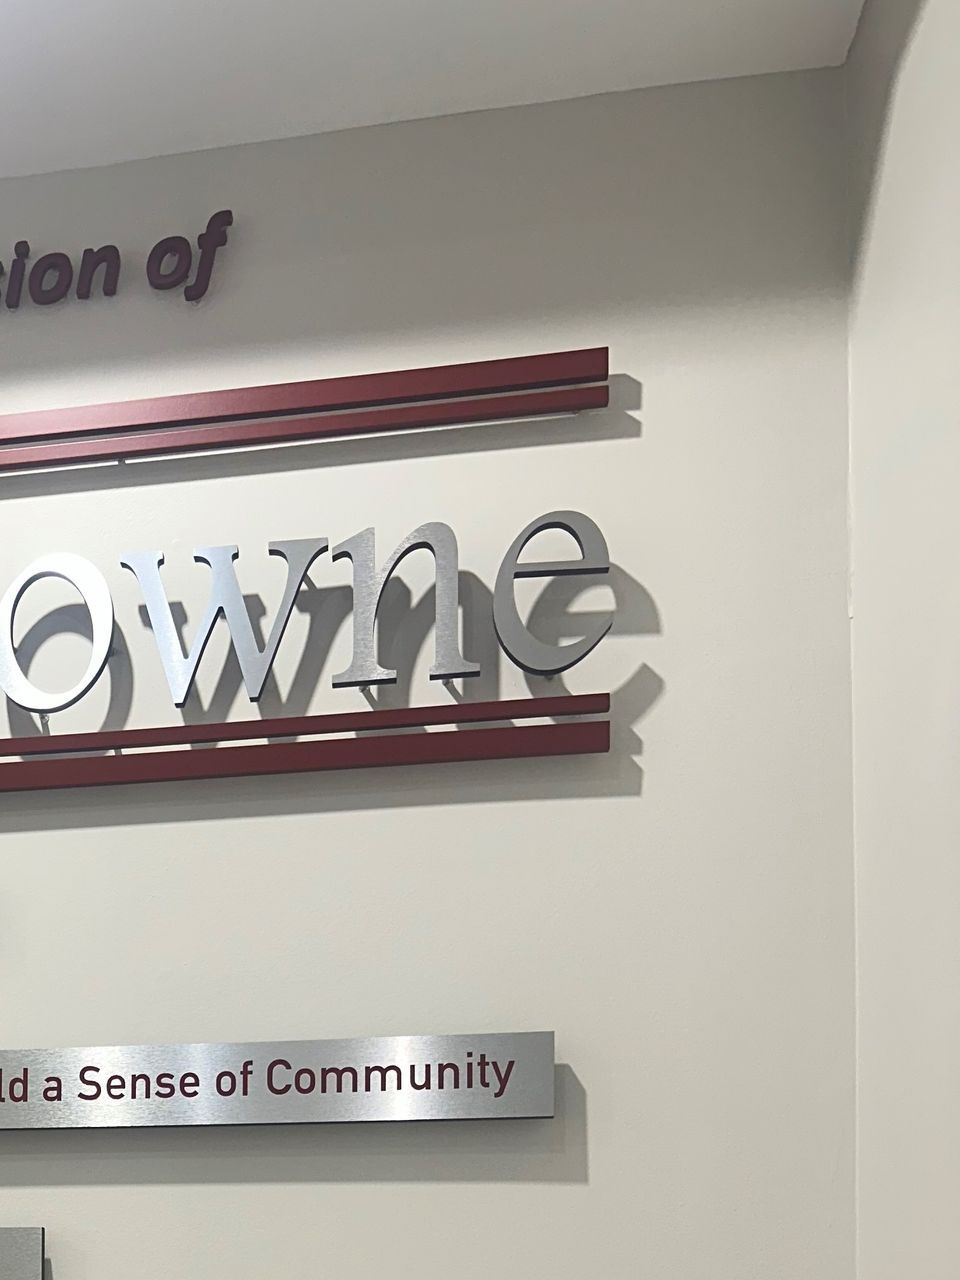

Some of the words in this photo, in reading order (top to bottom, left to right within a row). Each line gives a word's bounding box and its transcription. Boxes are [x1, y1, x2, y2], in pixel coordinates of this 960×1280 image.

[146, 209, 234, 302] of
[42, 1076, 64, 1102] a
[78, 1065, 201, 1101] Sense
[215, 1060, 254, 1097] of
[266, 1052, 516, 1098] Community
